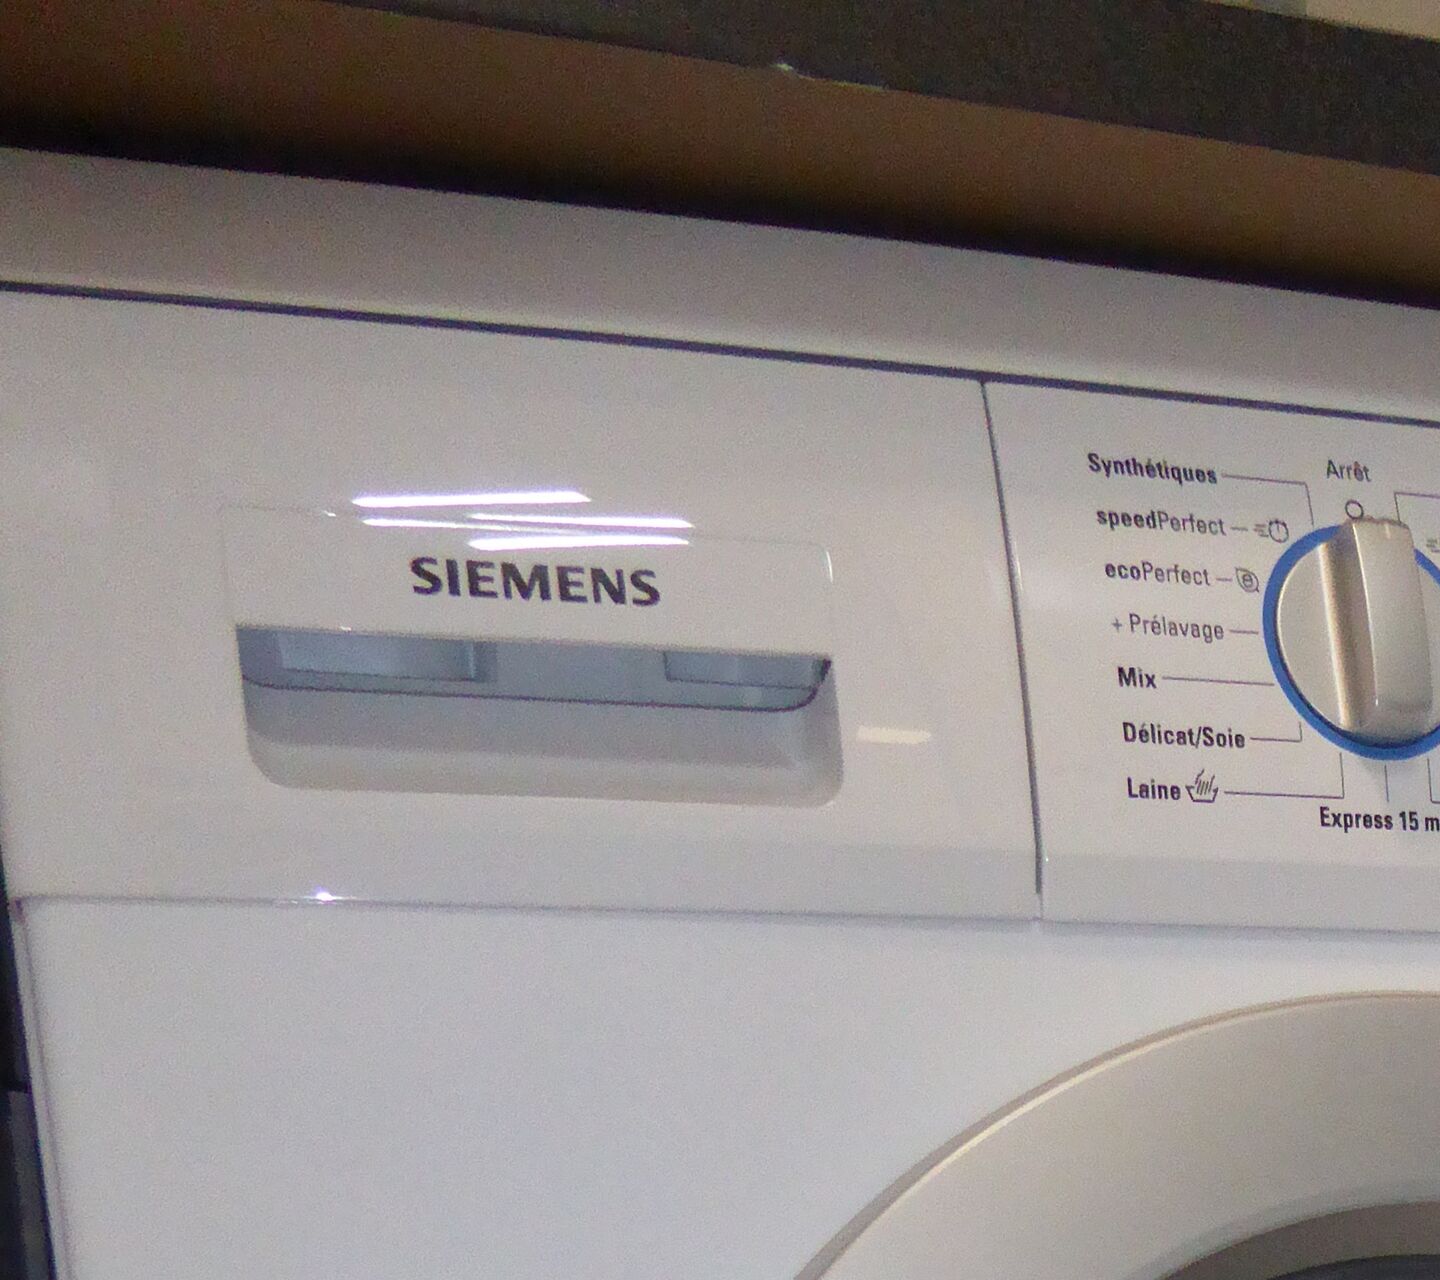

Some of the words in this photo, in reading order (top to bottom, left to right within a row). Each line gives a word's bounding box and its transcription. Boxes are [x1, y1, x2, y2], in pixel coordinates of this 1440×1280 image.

[1087, 453, 1218, 486] Synthétiques
[1326, 459, 1372, 483] Arrêt
[1096, 509, 1226, 536] speedPerfect
[410, 556, 661, 606] SIEMENS
[1104, 562, 1211, 587] ecoPerfect
[1129, 613, 1225, 644] Prélavage
[1117, 667, 1157, 690] Mix
[1122, 722, 1246, 749] Délicat/Soie
[1127, 777, 1182, 800] Laine
[1320, 806, 1393, 834] Express
[1400, 811, 1419, 831] 15
